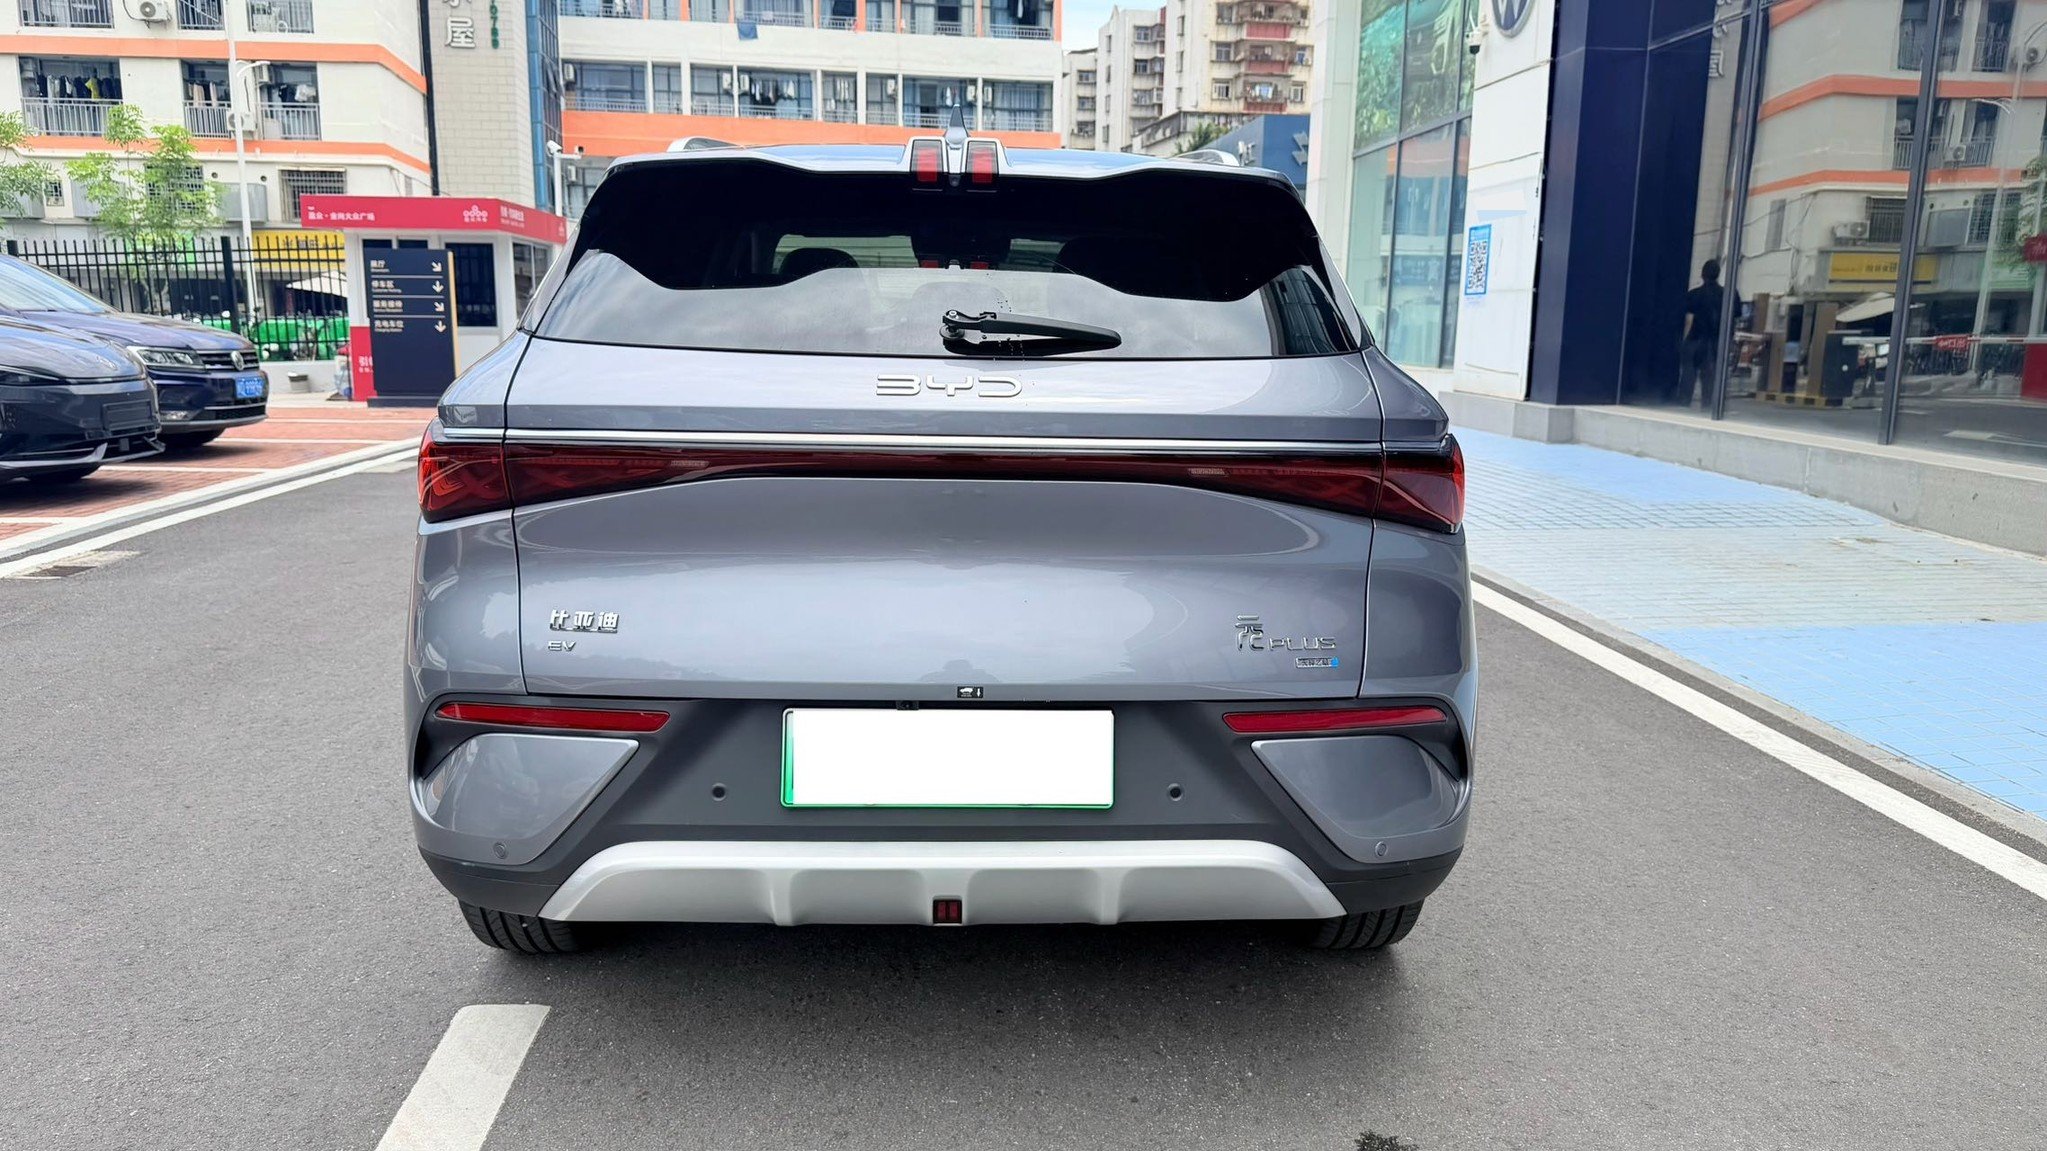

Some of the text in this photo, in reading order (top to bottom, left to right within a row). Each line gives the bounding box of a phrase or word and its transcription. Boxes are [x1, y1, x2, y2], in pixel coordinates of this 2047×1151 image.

[876, 374, 1022, 398] BYD
[549, 609, 619, 633] 比亚迪
[548, 640, 577, 652] EV
[1269, 636, 1336, 651] PLUS
